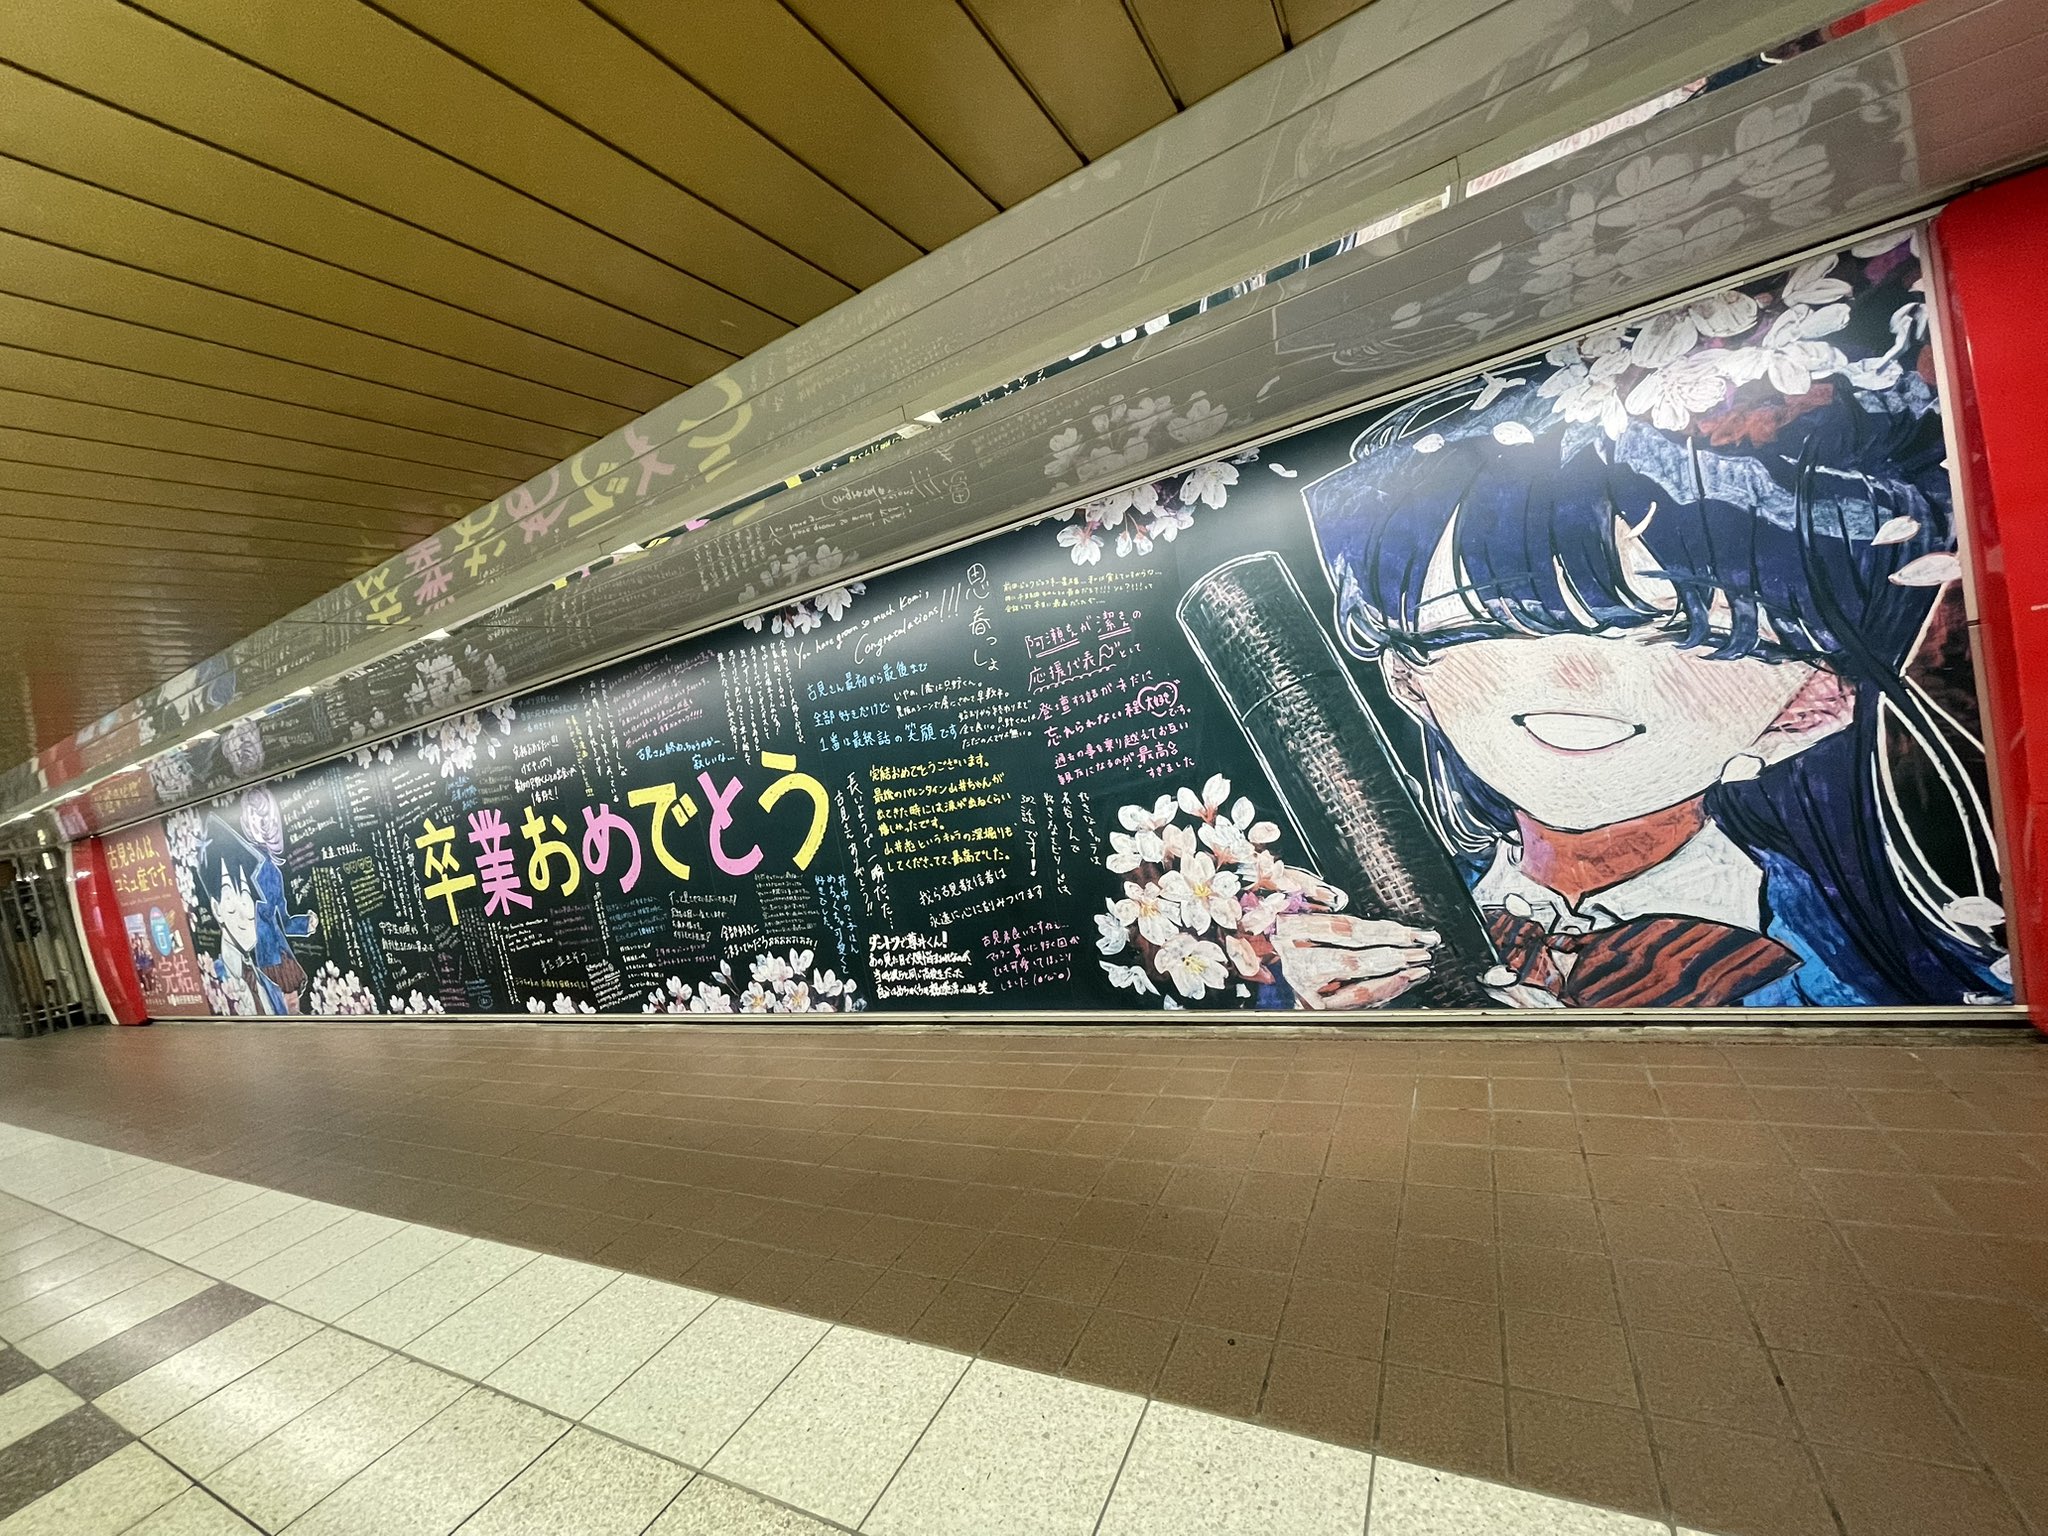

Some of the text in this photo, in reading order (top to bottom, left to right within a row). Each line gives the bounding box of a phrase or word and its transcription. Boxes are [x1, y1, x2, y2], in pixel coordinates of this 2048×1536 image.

[794, 642, 811, 669] You
[816, 639, 835, 653] have
[861, 618, 870, 629] so
[806, 661, 928, 701] 古見さん最初から最後まで
[813, 703, 891, 728] 全部好きだけど
[819, 723, 959, 752] 1番は最終話の笑顔です
[1055, 721, 1189, 769] 過去の事を乗り越えてお互い
[870, 752, 990, 782] 完結おめでとうございます。
[1145, 756, 1196, 779] すぎました
[873, 772, 1006, 805] 最後のバレンタイン山井ちゃんが
[876, 792, 1012, 821] 出てきた時には涙が出るくらい
[414, 751, 831, 926] 卒業おめでとう
[878, 816, 945, 838] 嬉しかったです。
[107, 835, 161, 870] 古見さんは、
[115, 862, 173, 893] コミュ症です。
[929, 885, 1043, 928] 永遠に心に刻みつけます
